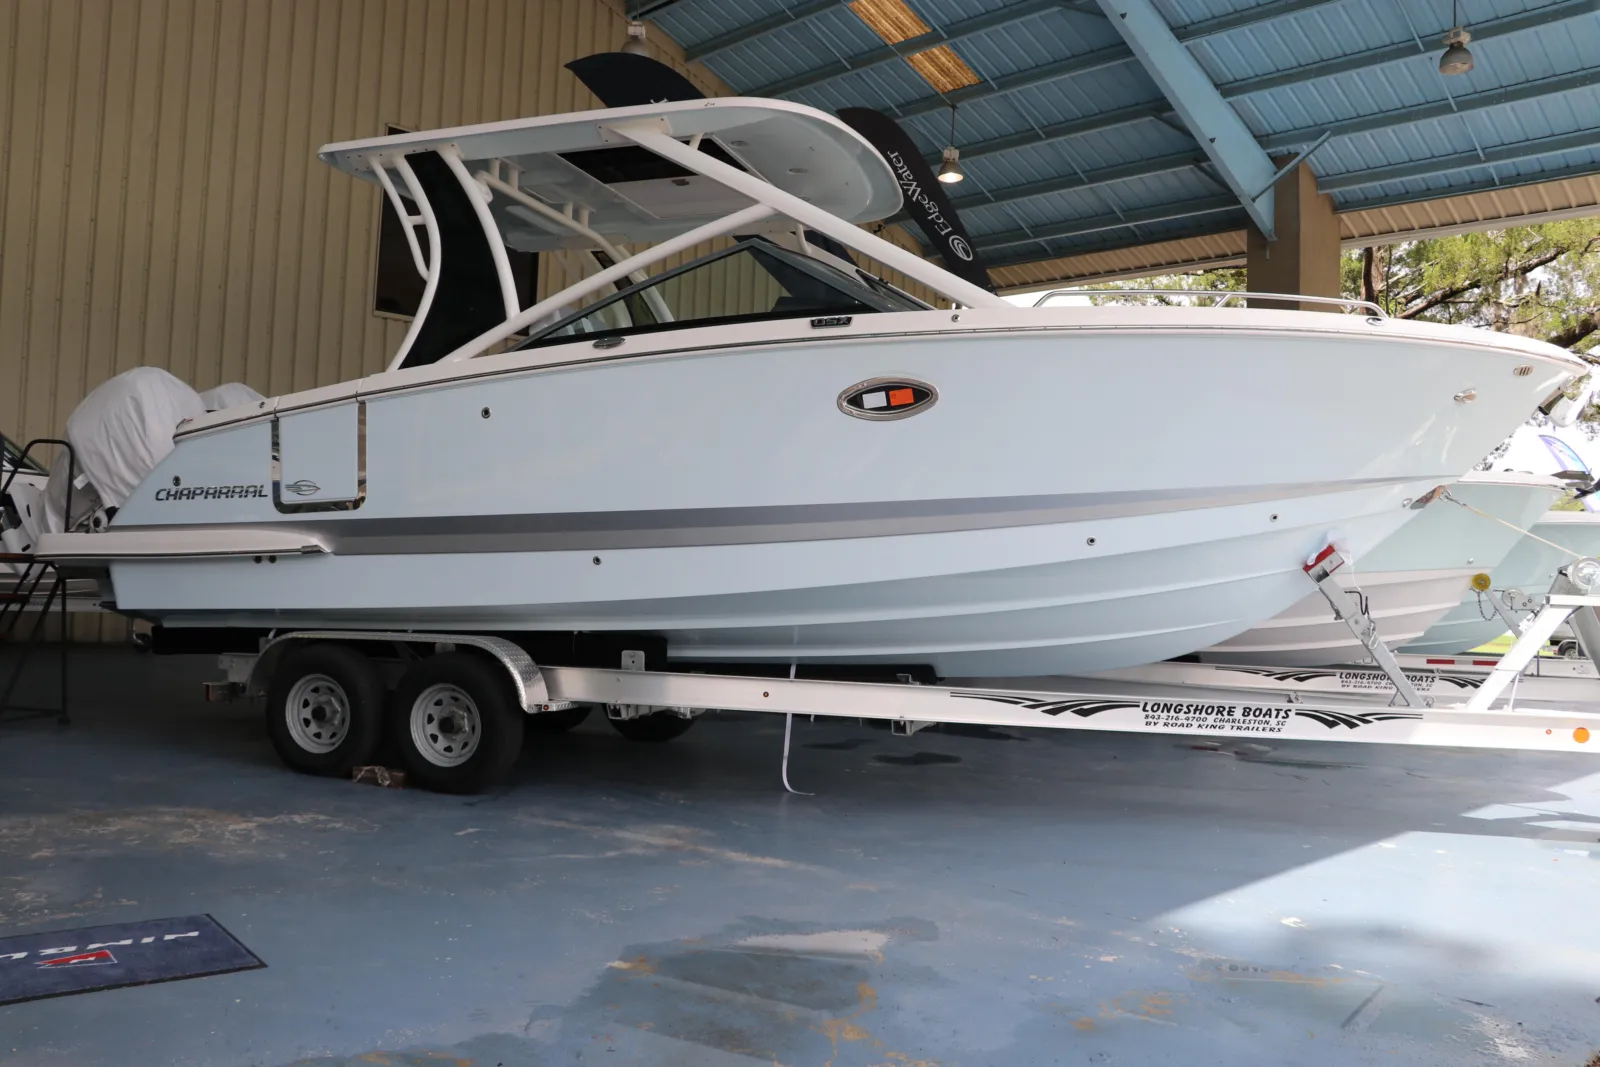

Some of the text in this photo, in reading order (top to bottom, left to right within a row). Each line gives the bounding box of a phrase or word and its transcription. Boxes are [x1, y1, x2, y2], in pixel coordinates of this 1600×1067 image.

[887, 150, 953, 236] EdgeWater
[155, 484, 269, 501] CHAPARRAL
[1339, 672, 1393, 681] LONGSHO
[1142, 702, 1292, 720] LONGSHORE BOATS
[1144, 713, 1208, 723] 843-216-4700
[1213, 717, 1272, 726] CHARLESTON,
[1230, 725, 1283, 733] TRAILERS
